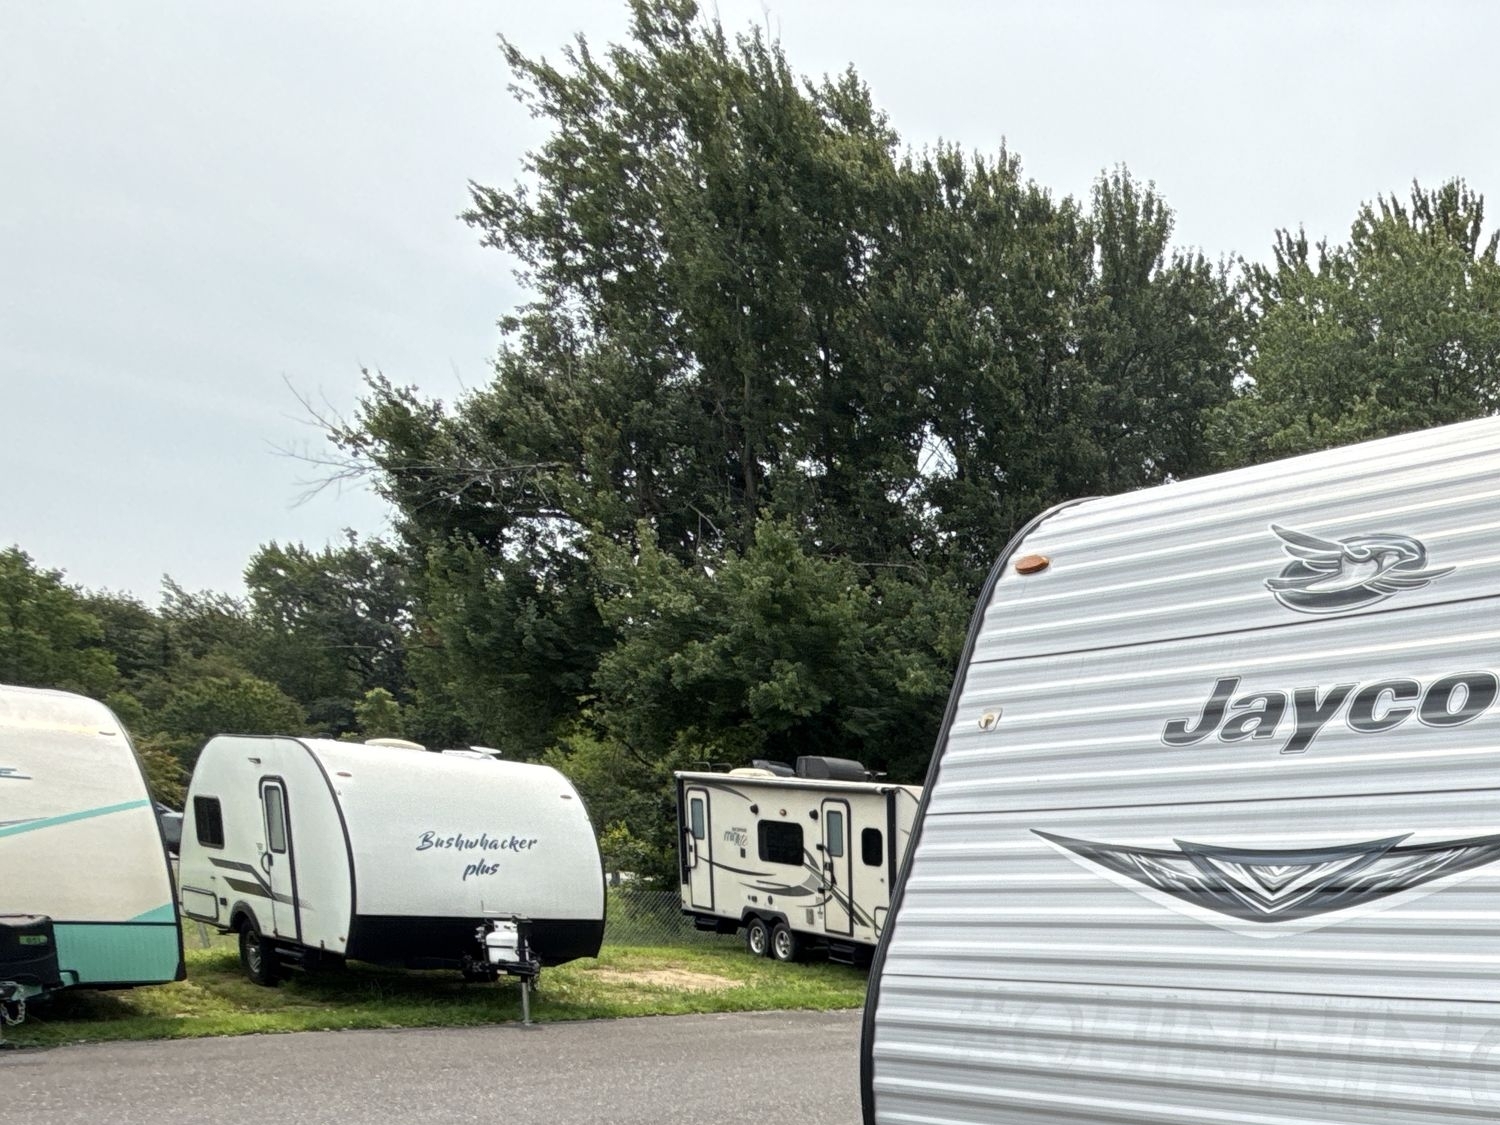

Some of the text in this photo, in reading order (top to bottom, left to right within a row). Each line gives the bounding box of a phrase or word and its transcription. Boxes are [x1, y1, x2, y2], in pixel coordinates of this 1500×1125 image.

[1160, 671, 1499, 754] Jayco
[416, 830, 537, 852] Bushwhacker
[462, 858, 500, 881] plus
